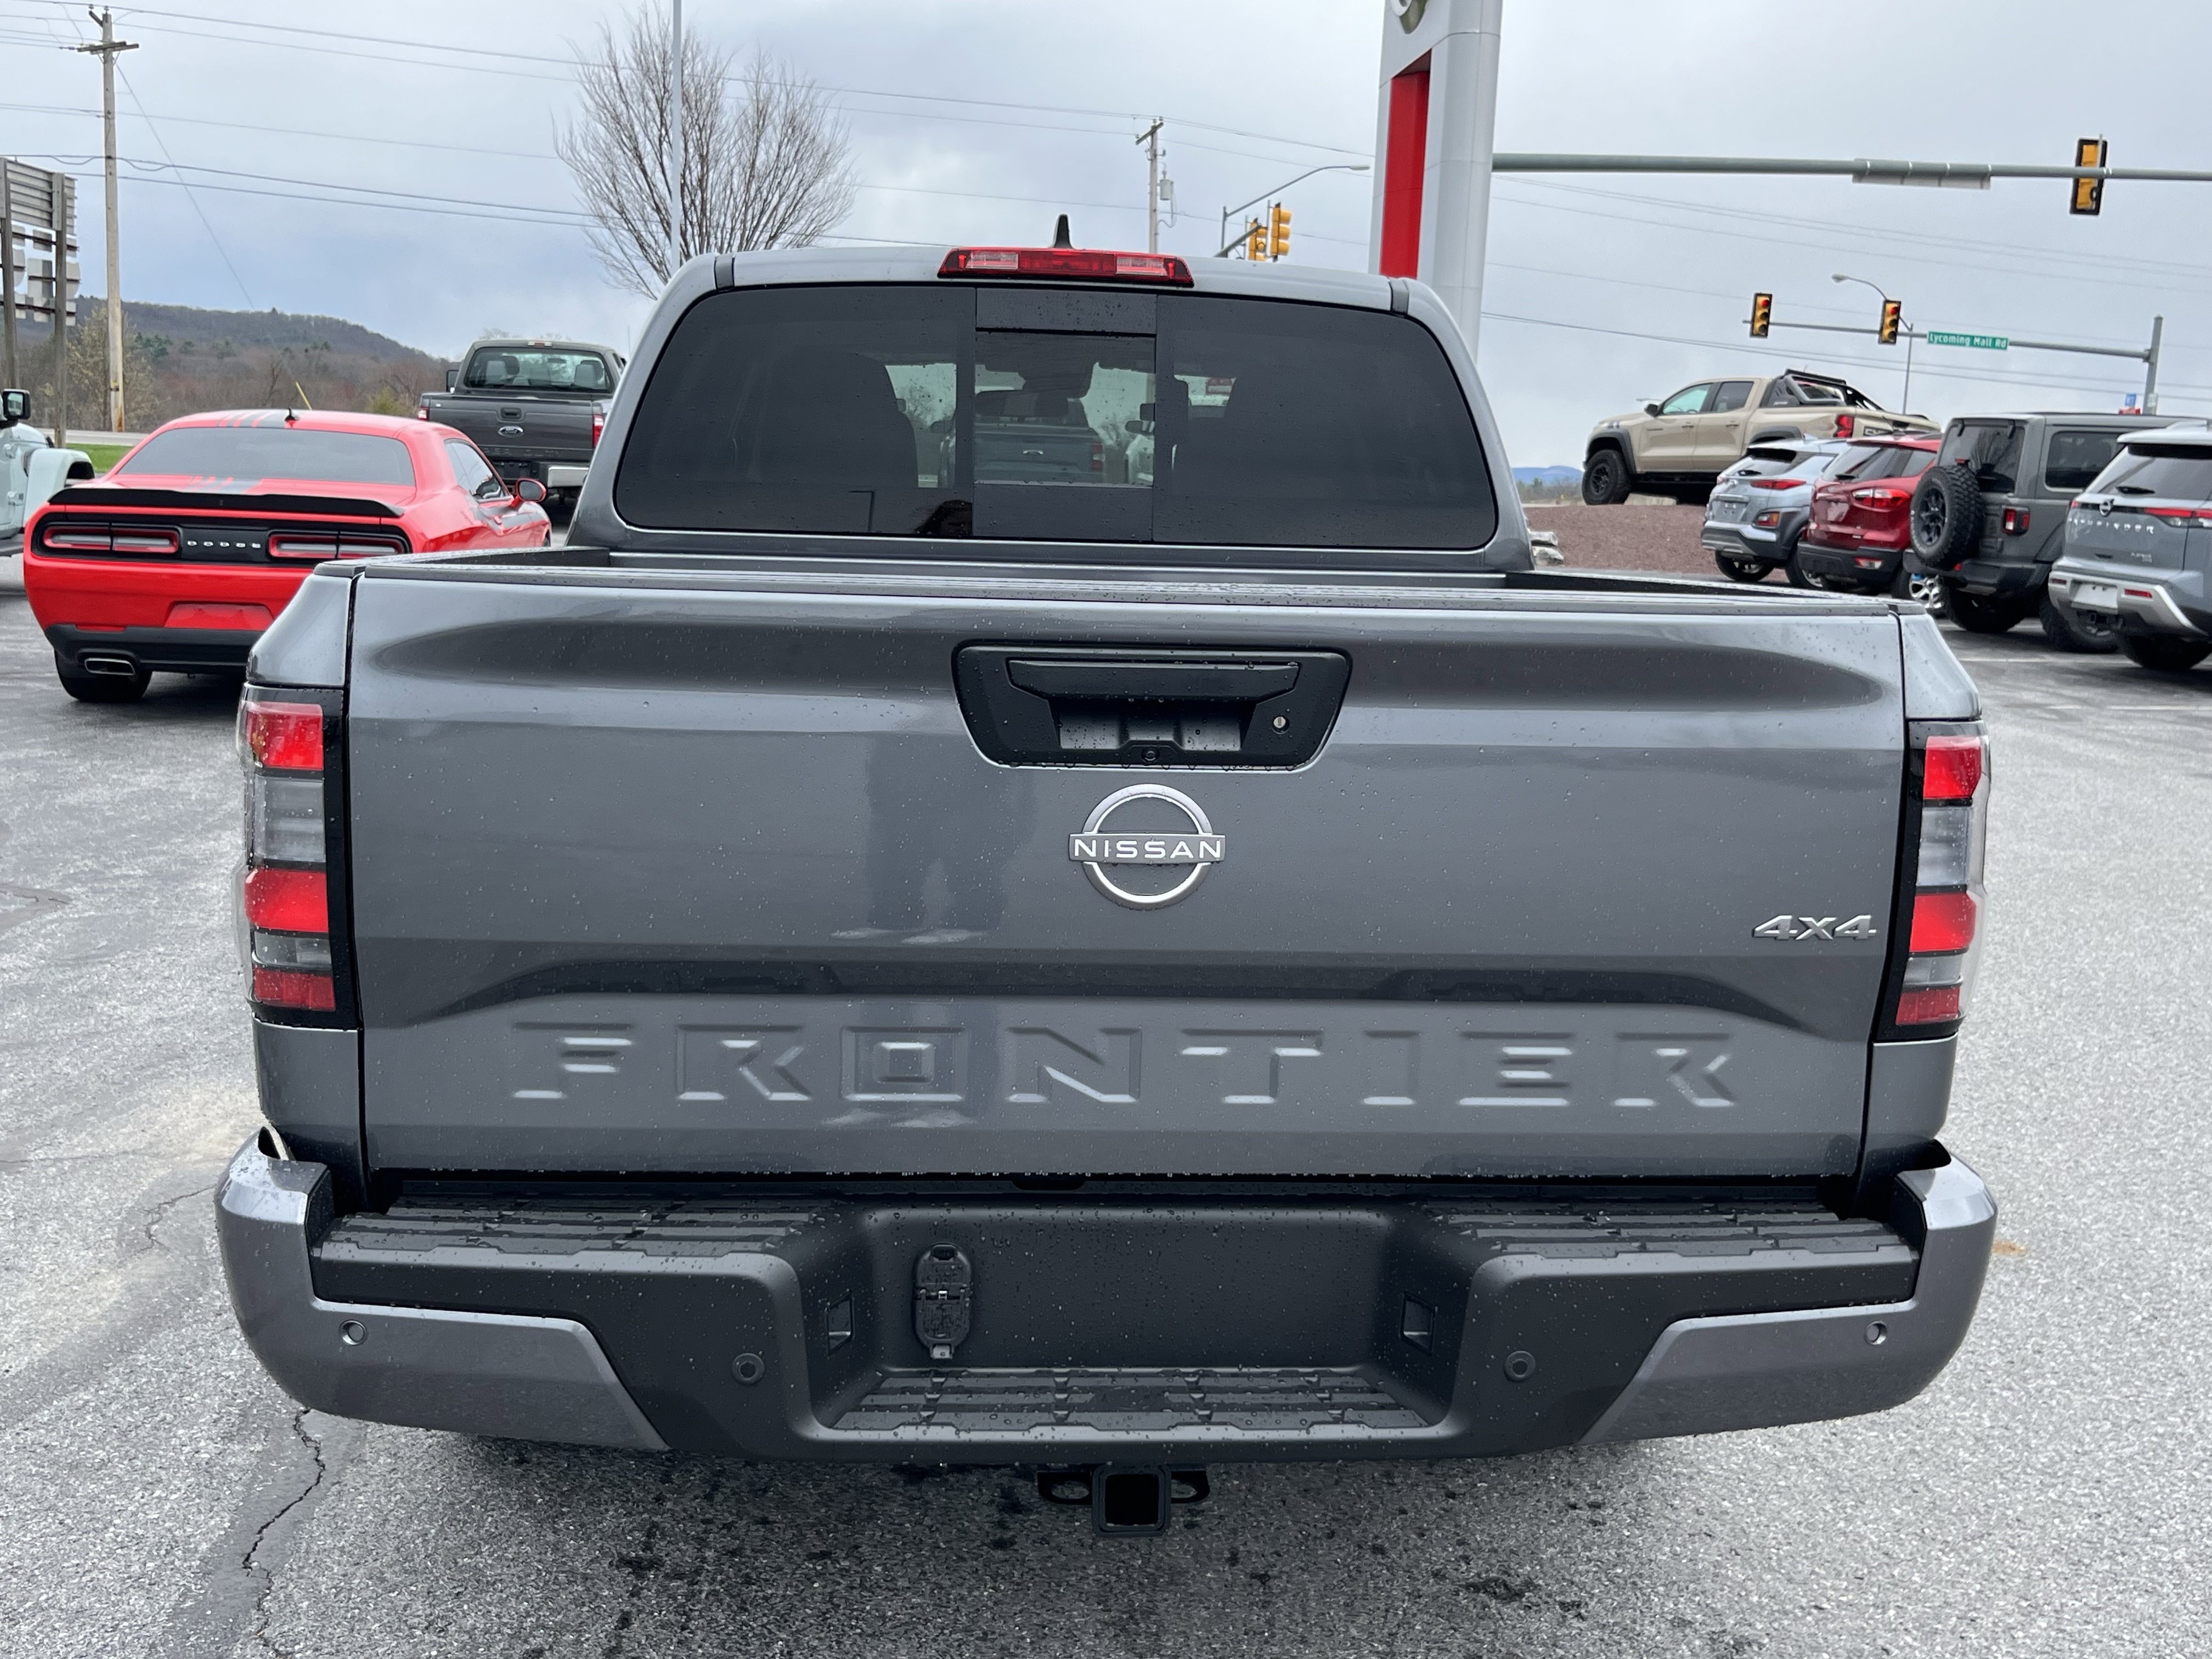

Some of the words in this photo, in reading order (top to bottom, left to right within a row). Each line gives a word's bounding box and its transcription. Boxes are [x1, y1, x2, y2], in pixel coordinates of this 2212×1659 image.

[1929, 333, 1971, 347] Lycoming
[1973, 337, 1993, 347] Mall
[1995, 339, 2007, 348] Rd
[1074, 839, 1221, 859] NISSAN
[512, 1022, 1735, 1107] FRONTIER
